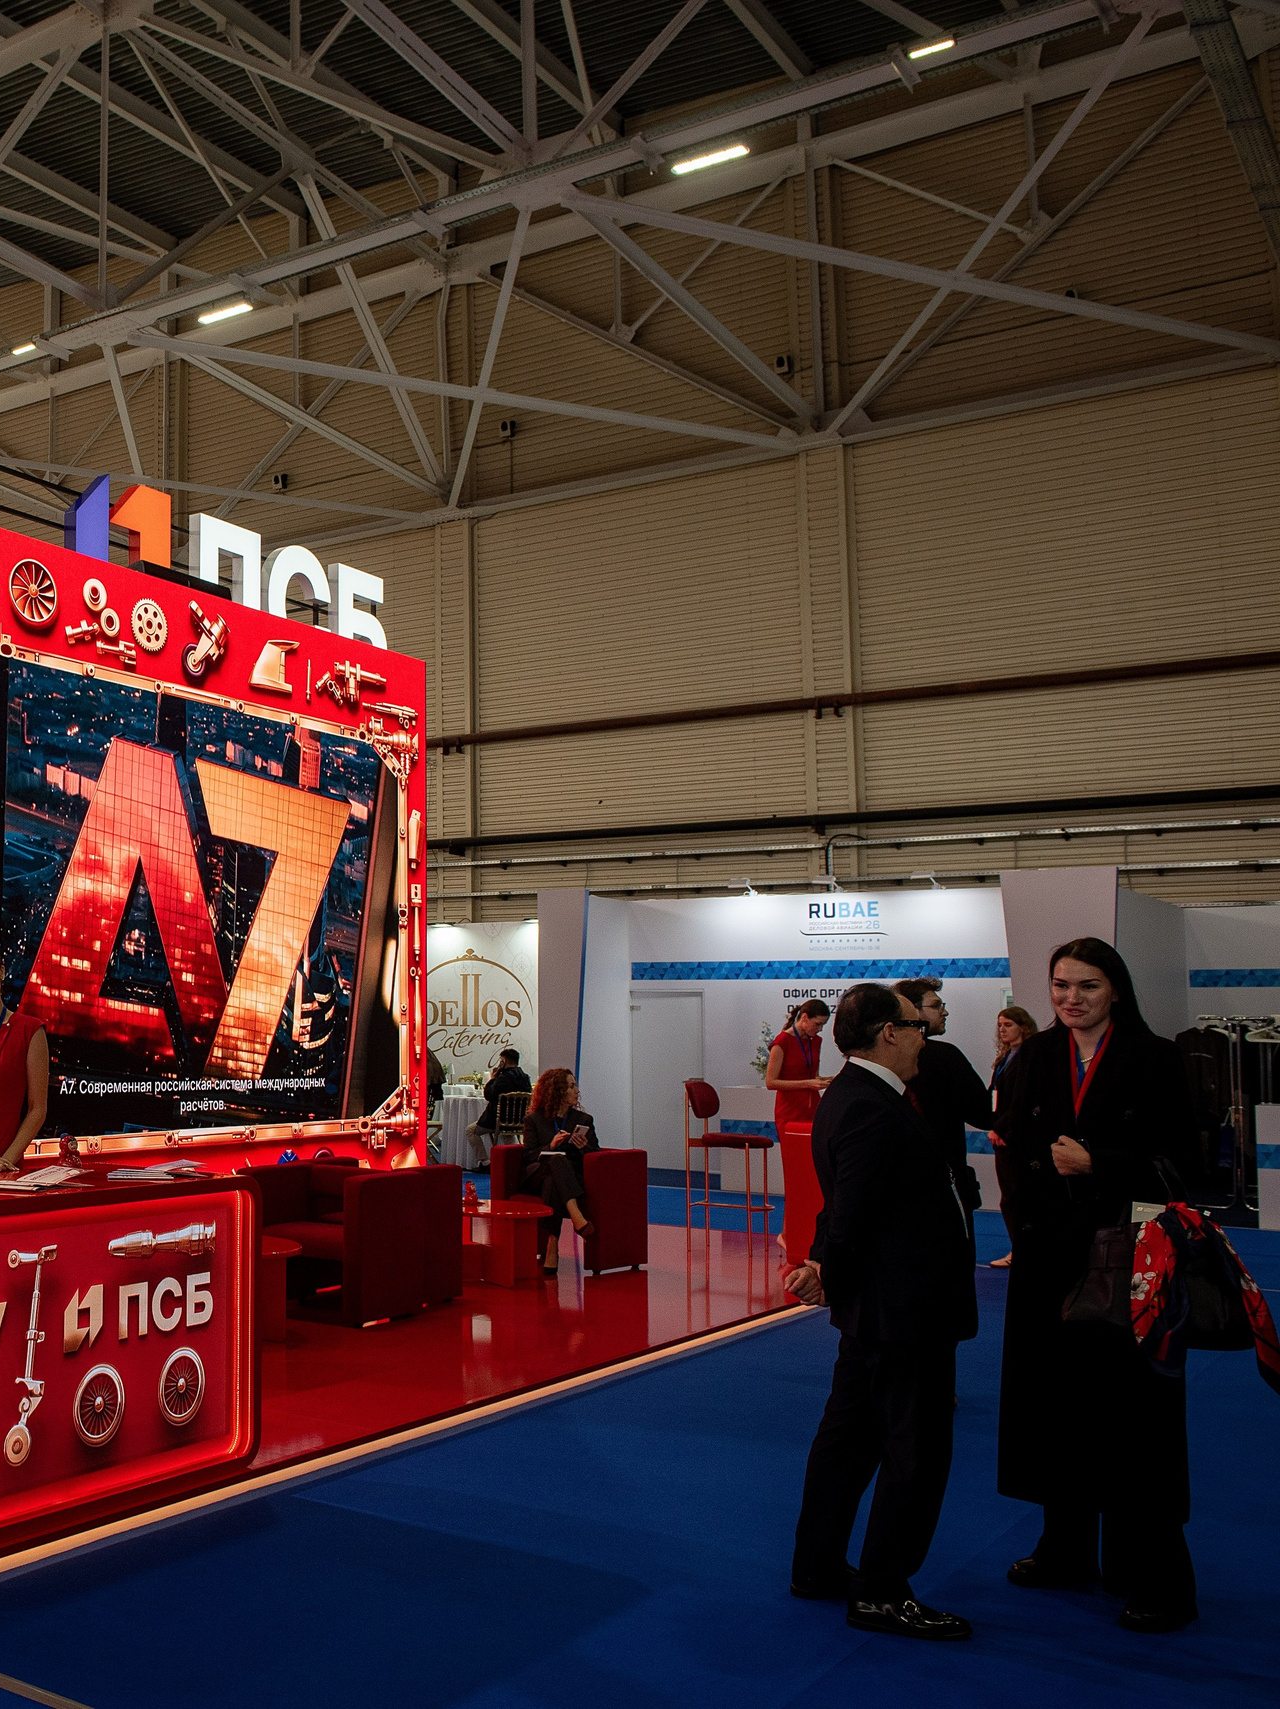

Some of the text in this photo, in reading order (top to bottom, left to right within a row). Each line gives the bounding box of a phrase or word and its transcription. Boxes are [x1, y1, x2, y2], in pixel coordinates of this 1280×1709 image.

[199, 512, 388, 650] ПСБ
[808, 901, 879, 919] RUBAE
[865, 920, 880, 930] 26
[783, 988, 817, 998] ОФИС
[427, 1027, 516, 1069] Catering
[79, 1079, 152, 1097] Современная
[154, 1077, 212, 1095] российская
[214, 1079, 252, 1091] система
[254, 1077, 326, 1092] международных
[180, 1098, 227, 1115] расчётов.
[118, 1271, 214, 1341] ПСБ
